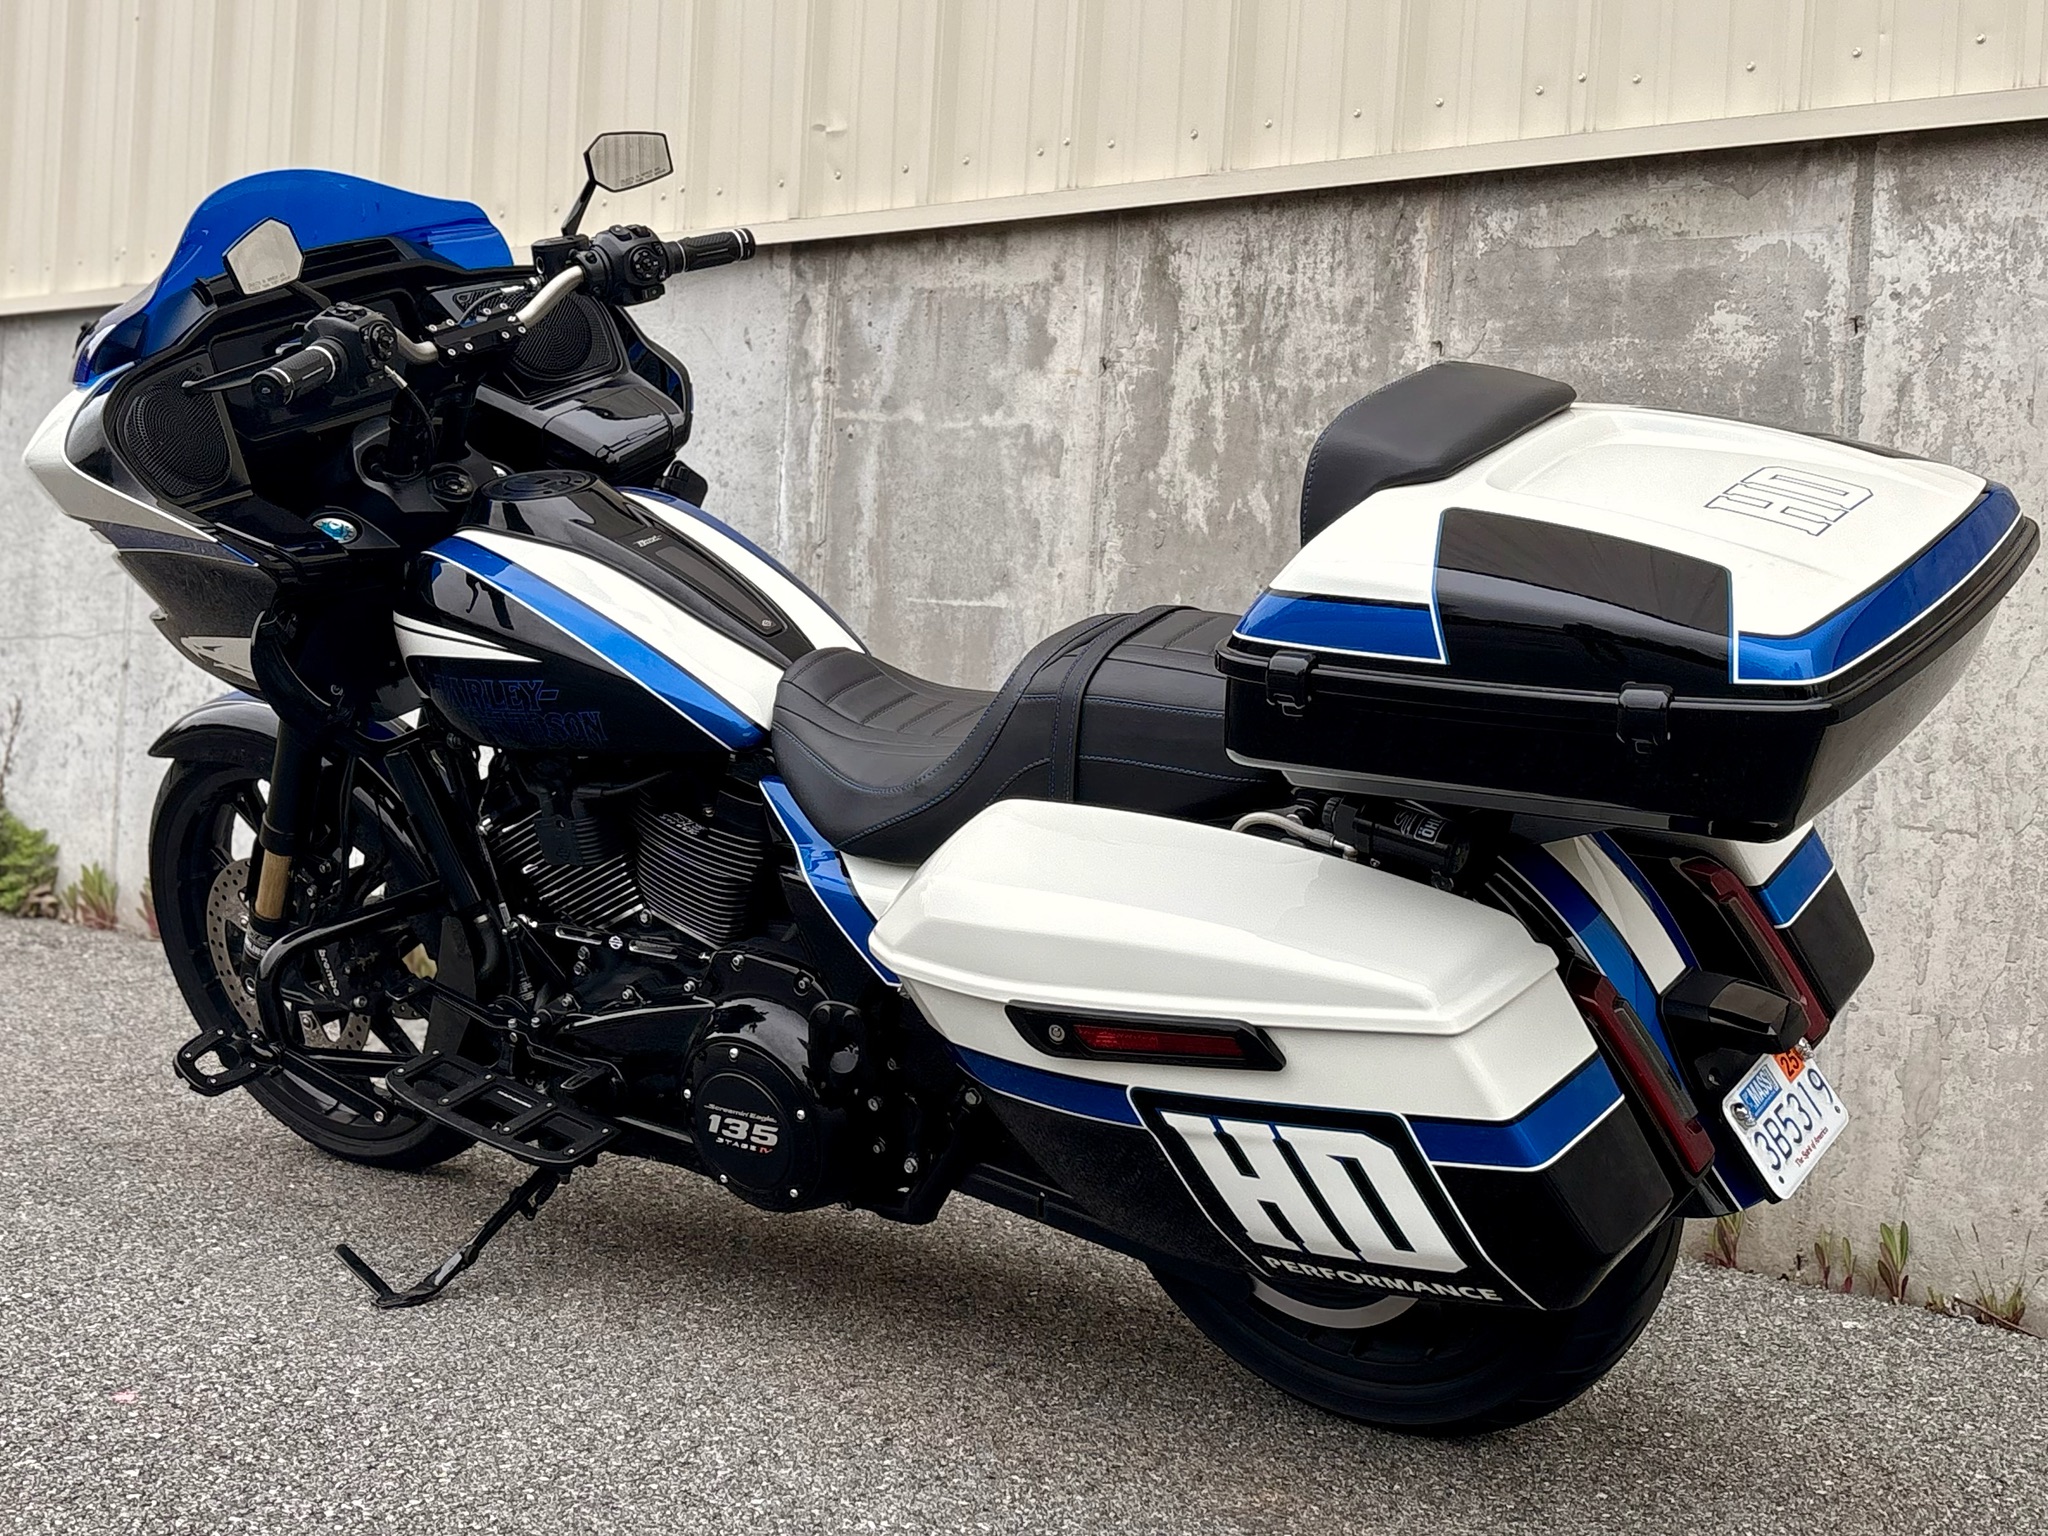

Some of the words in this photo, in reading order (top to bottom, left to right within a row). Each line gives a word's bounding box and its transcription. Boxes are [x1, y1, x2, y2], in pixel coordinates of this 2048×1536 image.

[1703, 466, 1874, 537] HD
[474, 710, 609, 750] VIDSON
[1418, 818, 1443, 838] ÖHL
[318, 949, 340, 996] brembo
[1779, 1051, 1800, 1077] 25
[708, 1114, 779, 1147] 135
[749, 1112, 777, 1123] Eagle
[1754, 1068, 1834, 1171] 3B5319
[715, 1137, 757, 1151] STAGE
[1159, 1110, 1469, 1274] HD
[1261, 1255, 1504, 1302] PERFORMANCE
